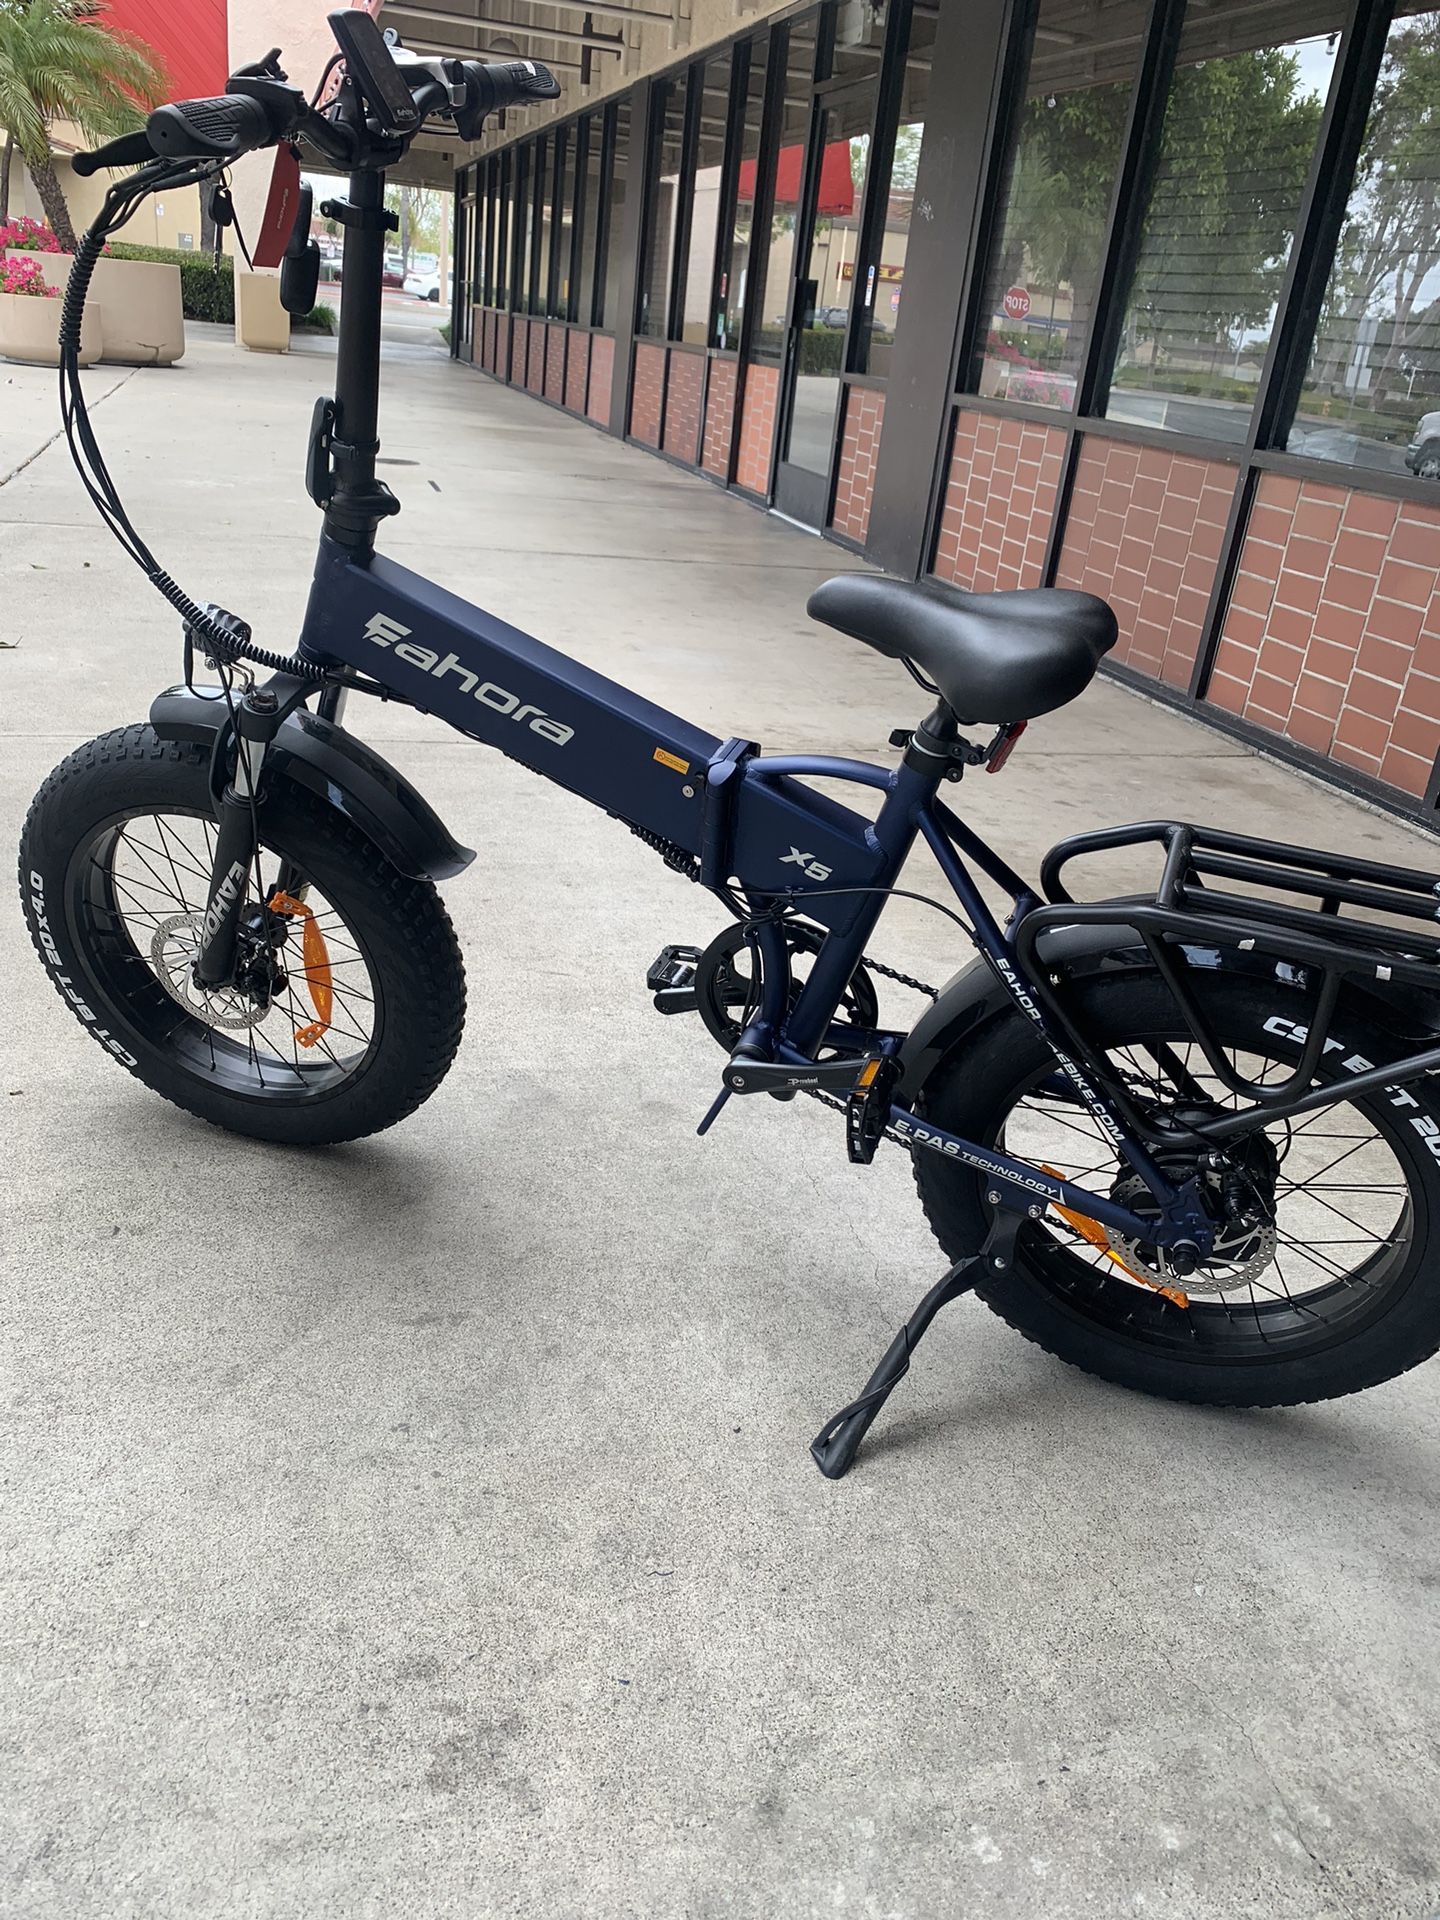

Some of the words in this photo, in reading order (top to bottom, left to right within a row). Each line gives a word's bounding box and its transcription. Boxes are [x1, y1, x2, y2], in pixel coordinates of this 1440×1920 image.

[362, 612, 575, 746] Eahora
[778, 845, 833, 882] X5
[201, 860, 248, 951] EAHOR
[55, 971, 98, 1022] BFT
[92, 1026, 139, 1068] CST
[996, 957, 1126, 1142] EAHOREBIKE.COM
[961, 1150, 1058, 1195] TECHNOLOGY
